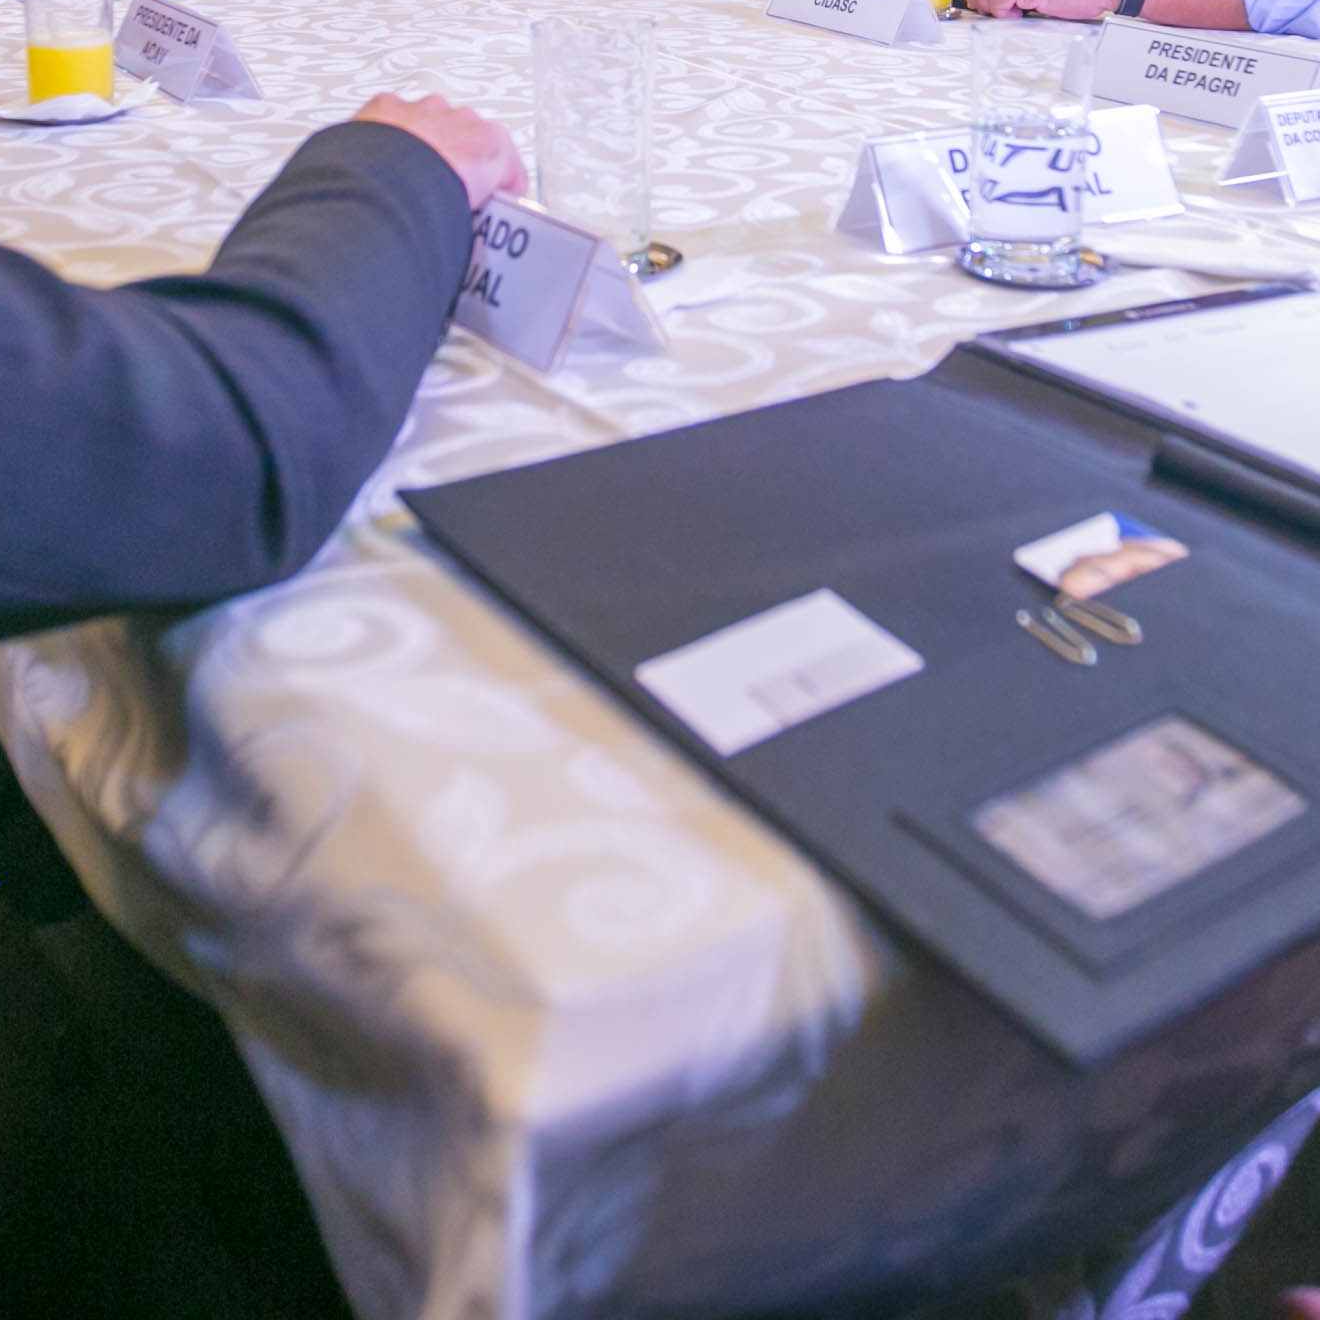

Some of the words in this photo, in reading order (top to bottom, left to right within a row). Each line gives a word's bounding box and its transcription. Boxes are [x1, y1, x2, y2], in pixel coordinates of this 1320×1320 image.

[134, 5, 189, 43] PRESIDENTE
[1148, 40, 1259, 75] PRESIDENTE
[1144, 63, 1168, 82] DA
[1173, 69, 1242, 98] EPAGRI
[1282, 132, 1302, 147] DA
